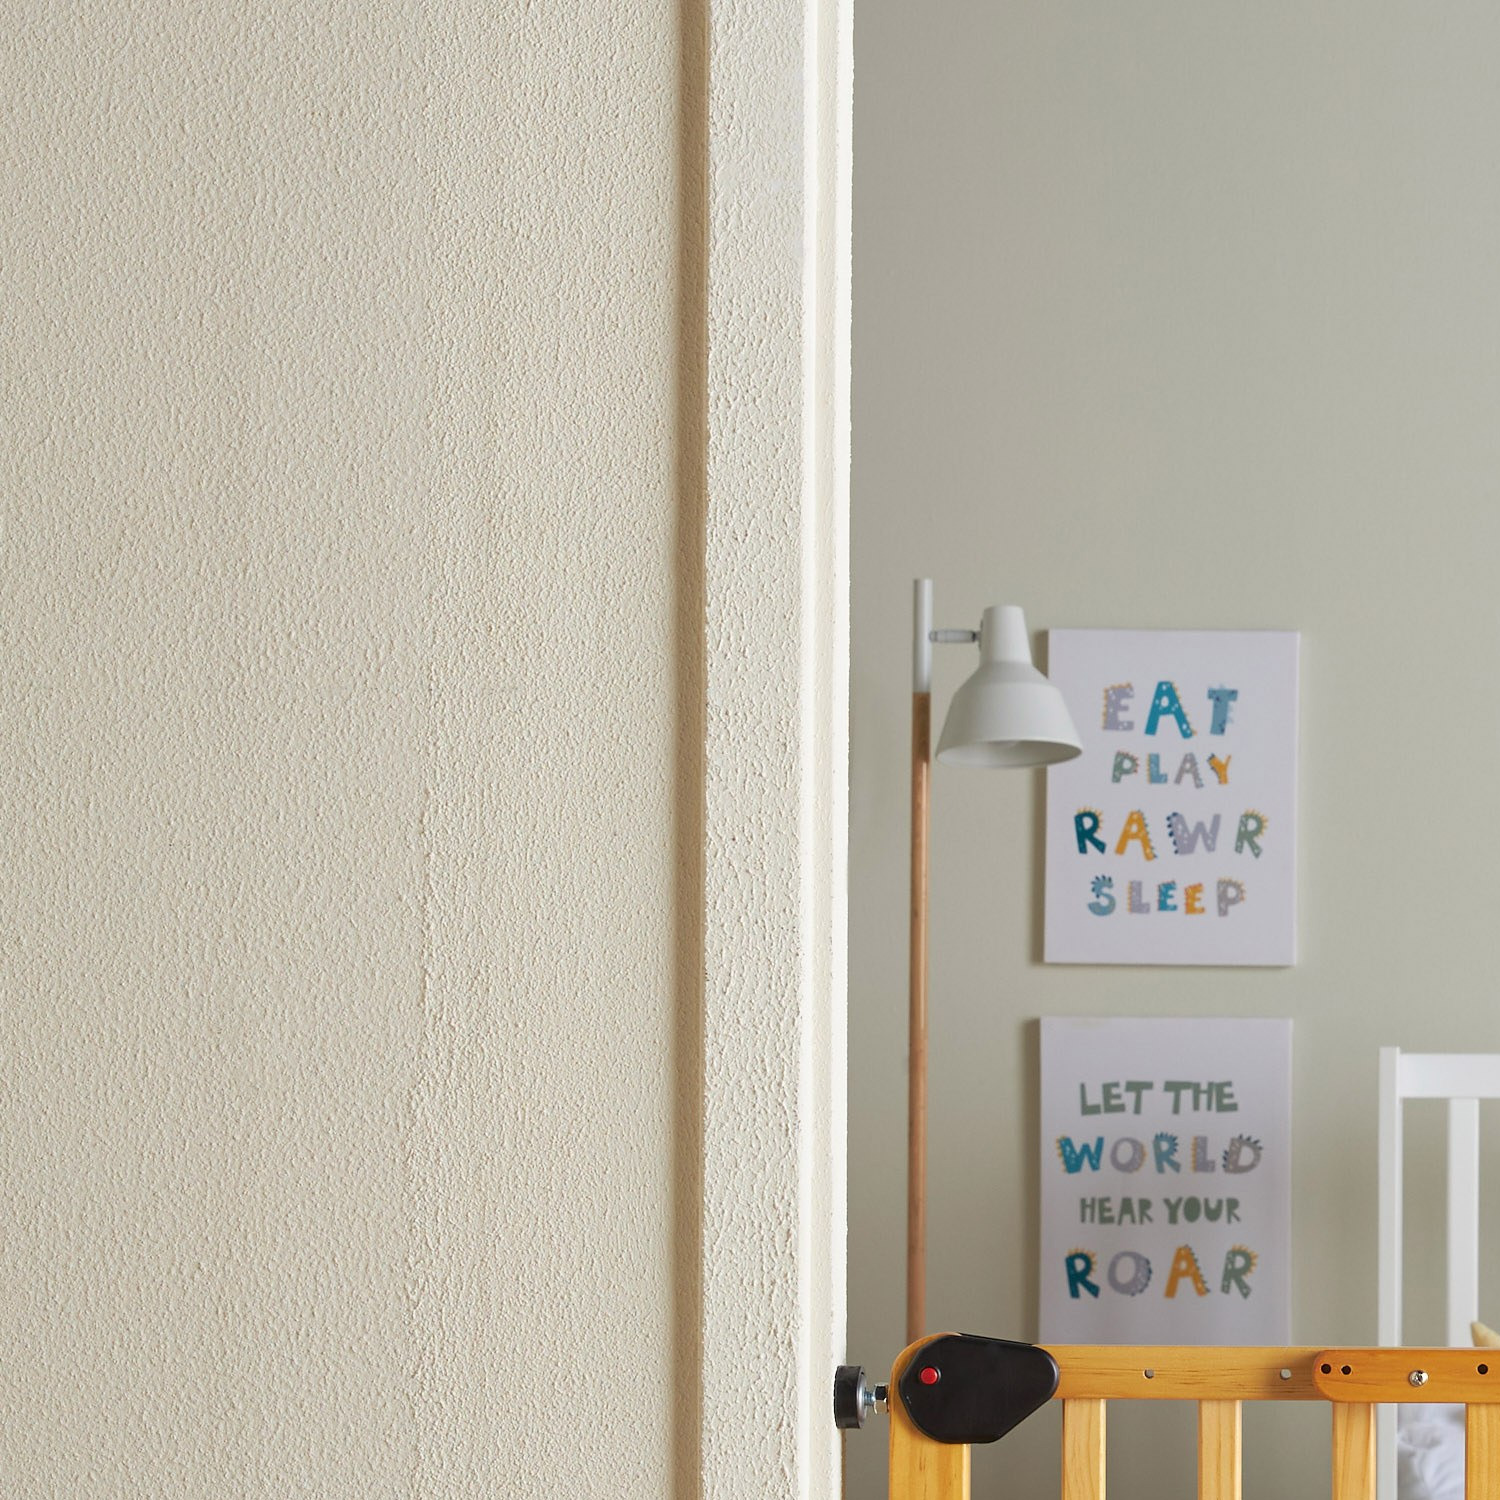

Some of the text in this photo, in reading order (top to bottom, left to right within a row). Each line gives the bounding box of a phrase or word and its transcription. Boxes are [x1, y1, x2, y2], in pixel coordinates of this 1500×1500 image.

[1102, 681, 1238, 739] EAT
[1111, 750, 1231, 789] PLAY
[1073, 808, 1268, 861] RAWR
[1088, 875, 1246, 917] SLEEP
[1080, 1081, 1238, 1116] LET THE
[1056, 1132, 1263, 1174] WORLD
[1080, 1196, 1240, 1226] HEAR YOUR
[1064, 1244, 1258, 1300] ROAR
